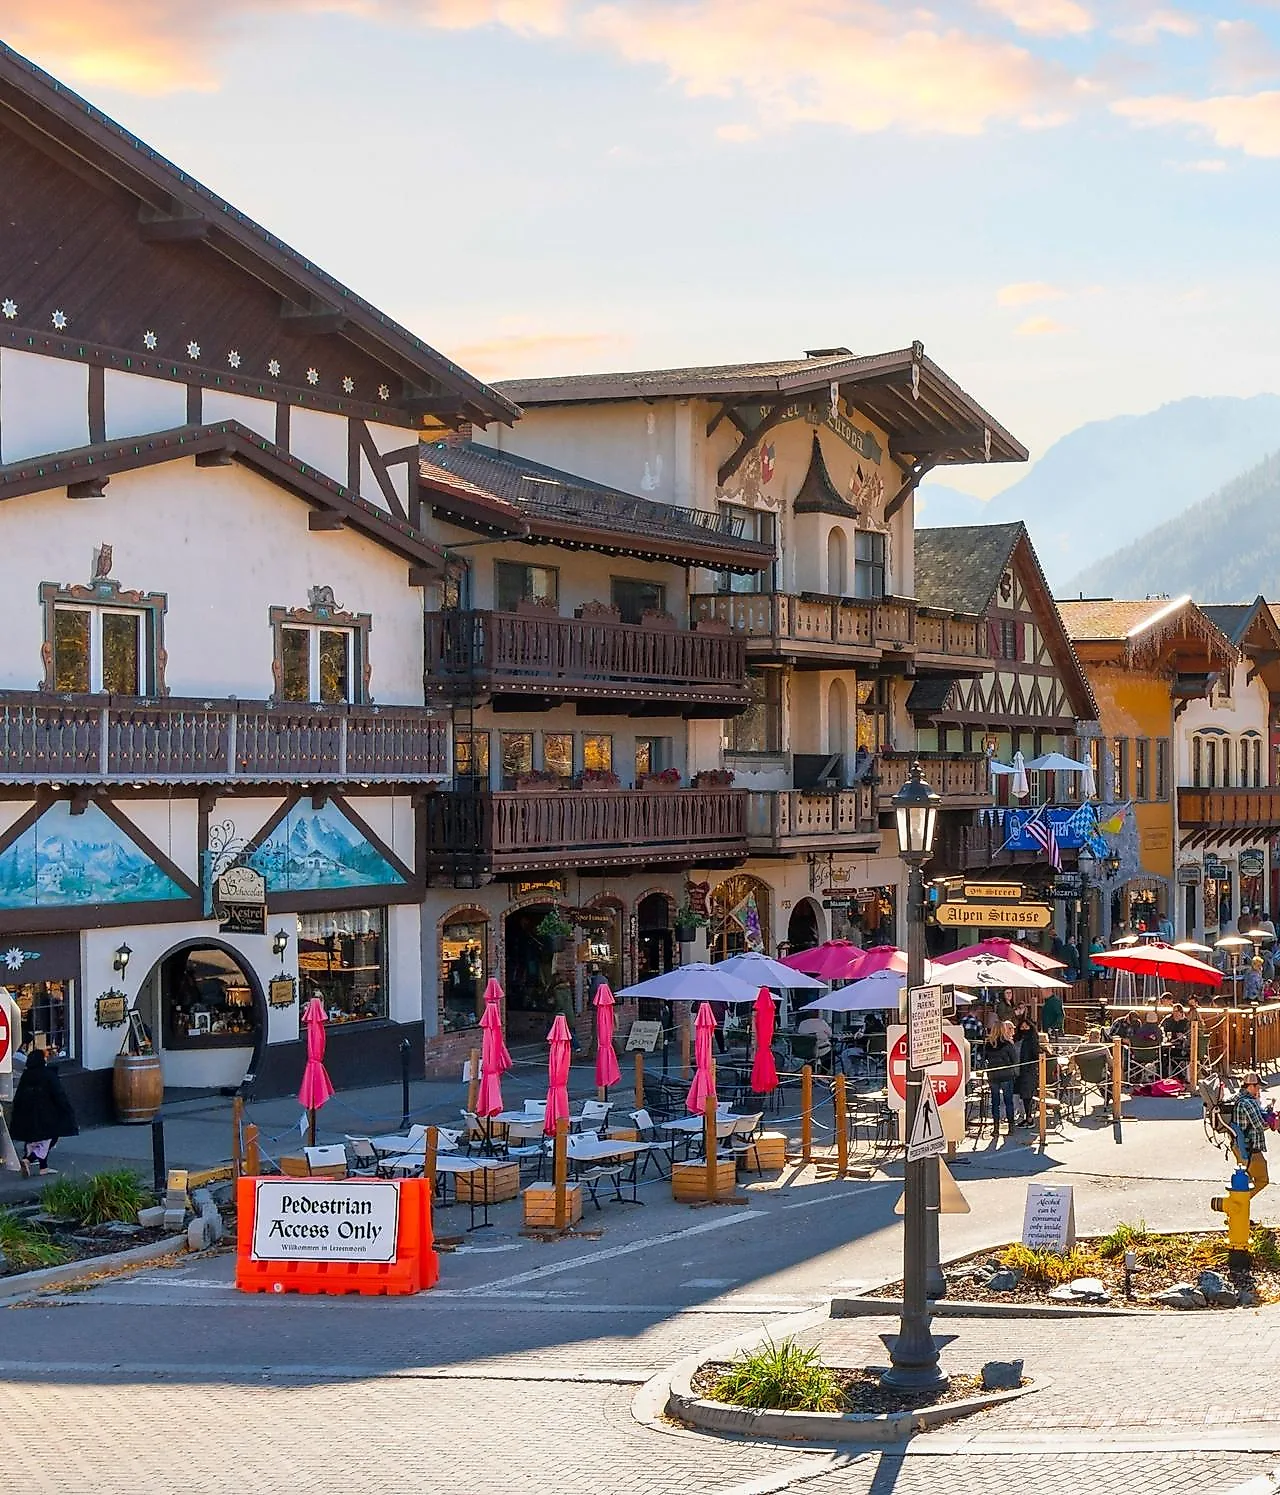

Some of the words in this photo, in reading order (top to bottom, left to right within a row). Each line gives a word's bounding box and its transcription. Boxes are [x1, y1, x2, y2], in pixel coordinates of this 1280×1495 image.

[985, 887, 1017, 896] Street
[231, 906, 263, 920] Kestrel
[947, 907, 983, 922] Alpen
[988, 908, 1039, 922] Strasse
[917, 999, 935, 1009] PARKING
[281, 1195, 372, 1215] Pedestrian
[1037, 1198, 1061, 1206] Alcohol
[269, 1219, 329, 1239] Access
[337, 1221, 382, 1245] Only
[1029, 1222, 1043, 1232] only
